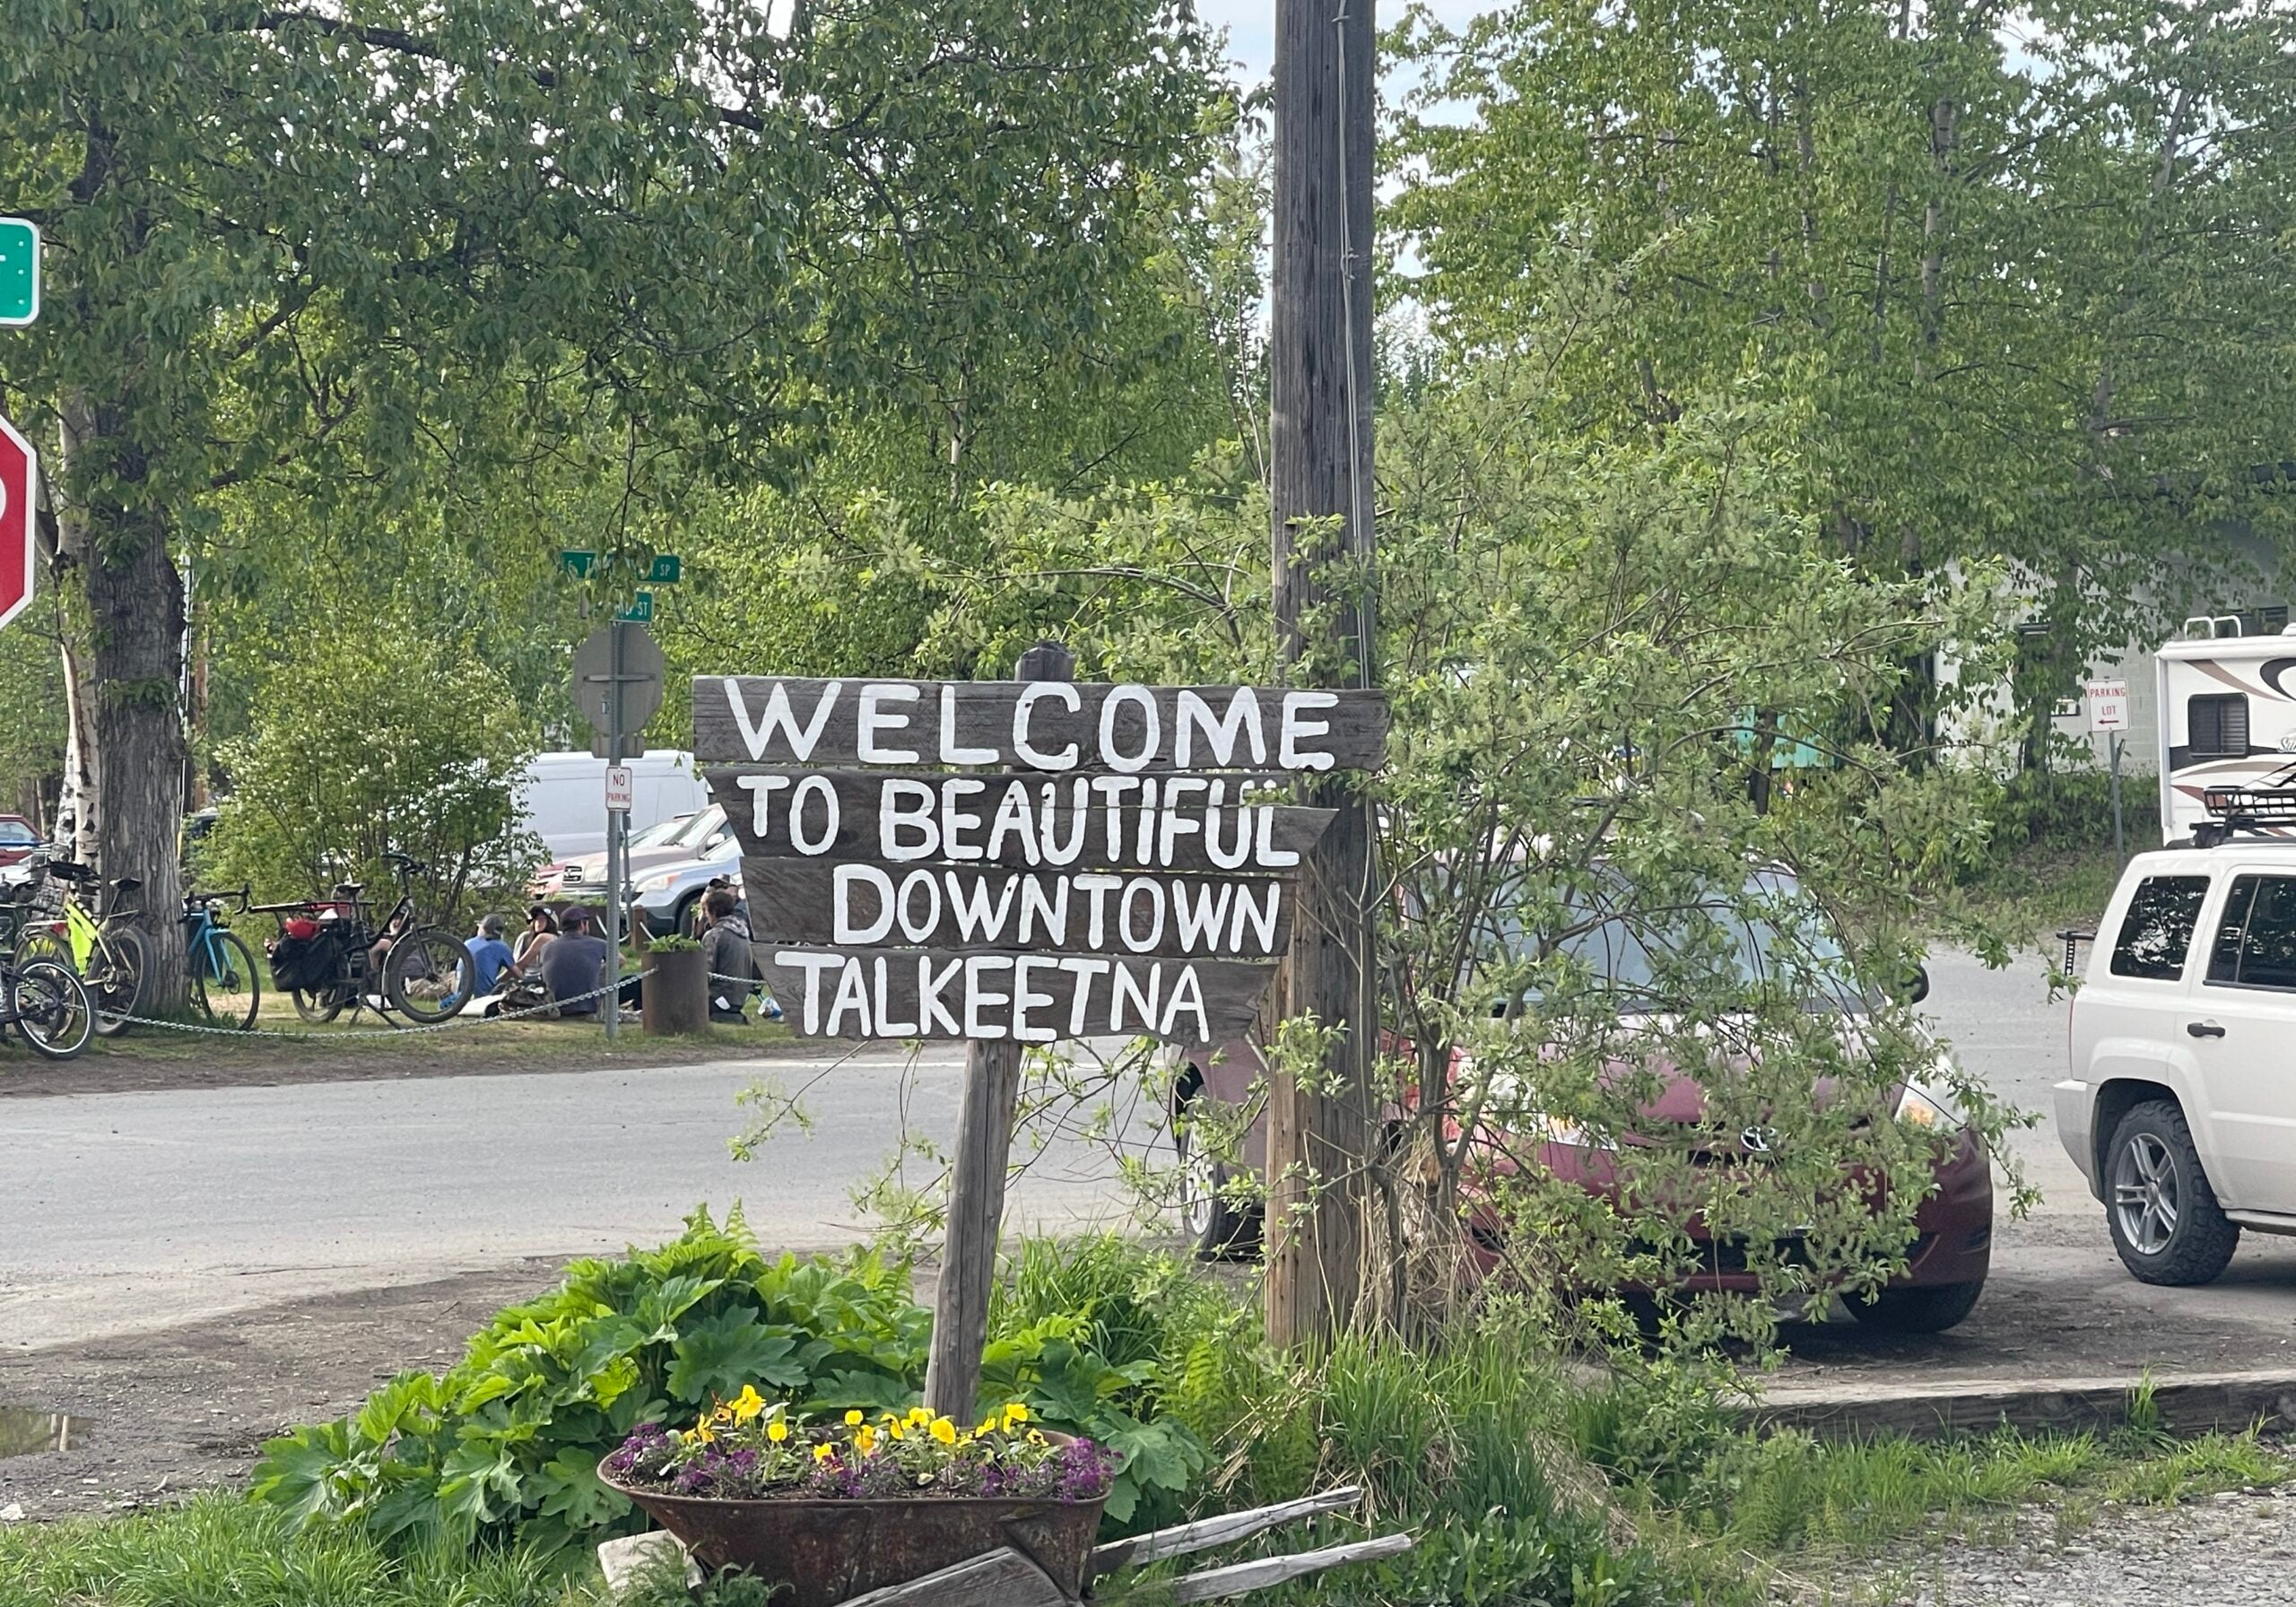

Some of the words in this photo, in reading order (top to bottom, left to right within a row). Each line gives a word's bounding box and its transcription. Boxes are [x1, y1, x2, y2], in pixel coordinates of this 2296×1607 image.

[638, 602, 648, 616] ST
[2091, 688, 2126, 698] PARKING
[2101, 705, 2117, 716] LOT
[723, 678, 1340, 772] WELCOME
[613, 774, 625, 786] NO
[607, 792, 631, 804] PARKING
[736, 774, 840, 856] TO
[880, 777, 1300, 868] BEAUTIFUL
[833, 864, 1281, 954] DOWNTOWN
[775, 951, 1210, 1043] TALKEETNA
